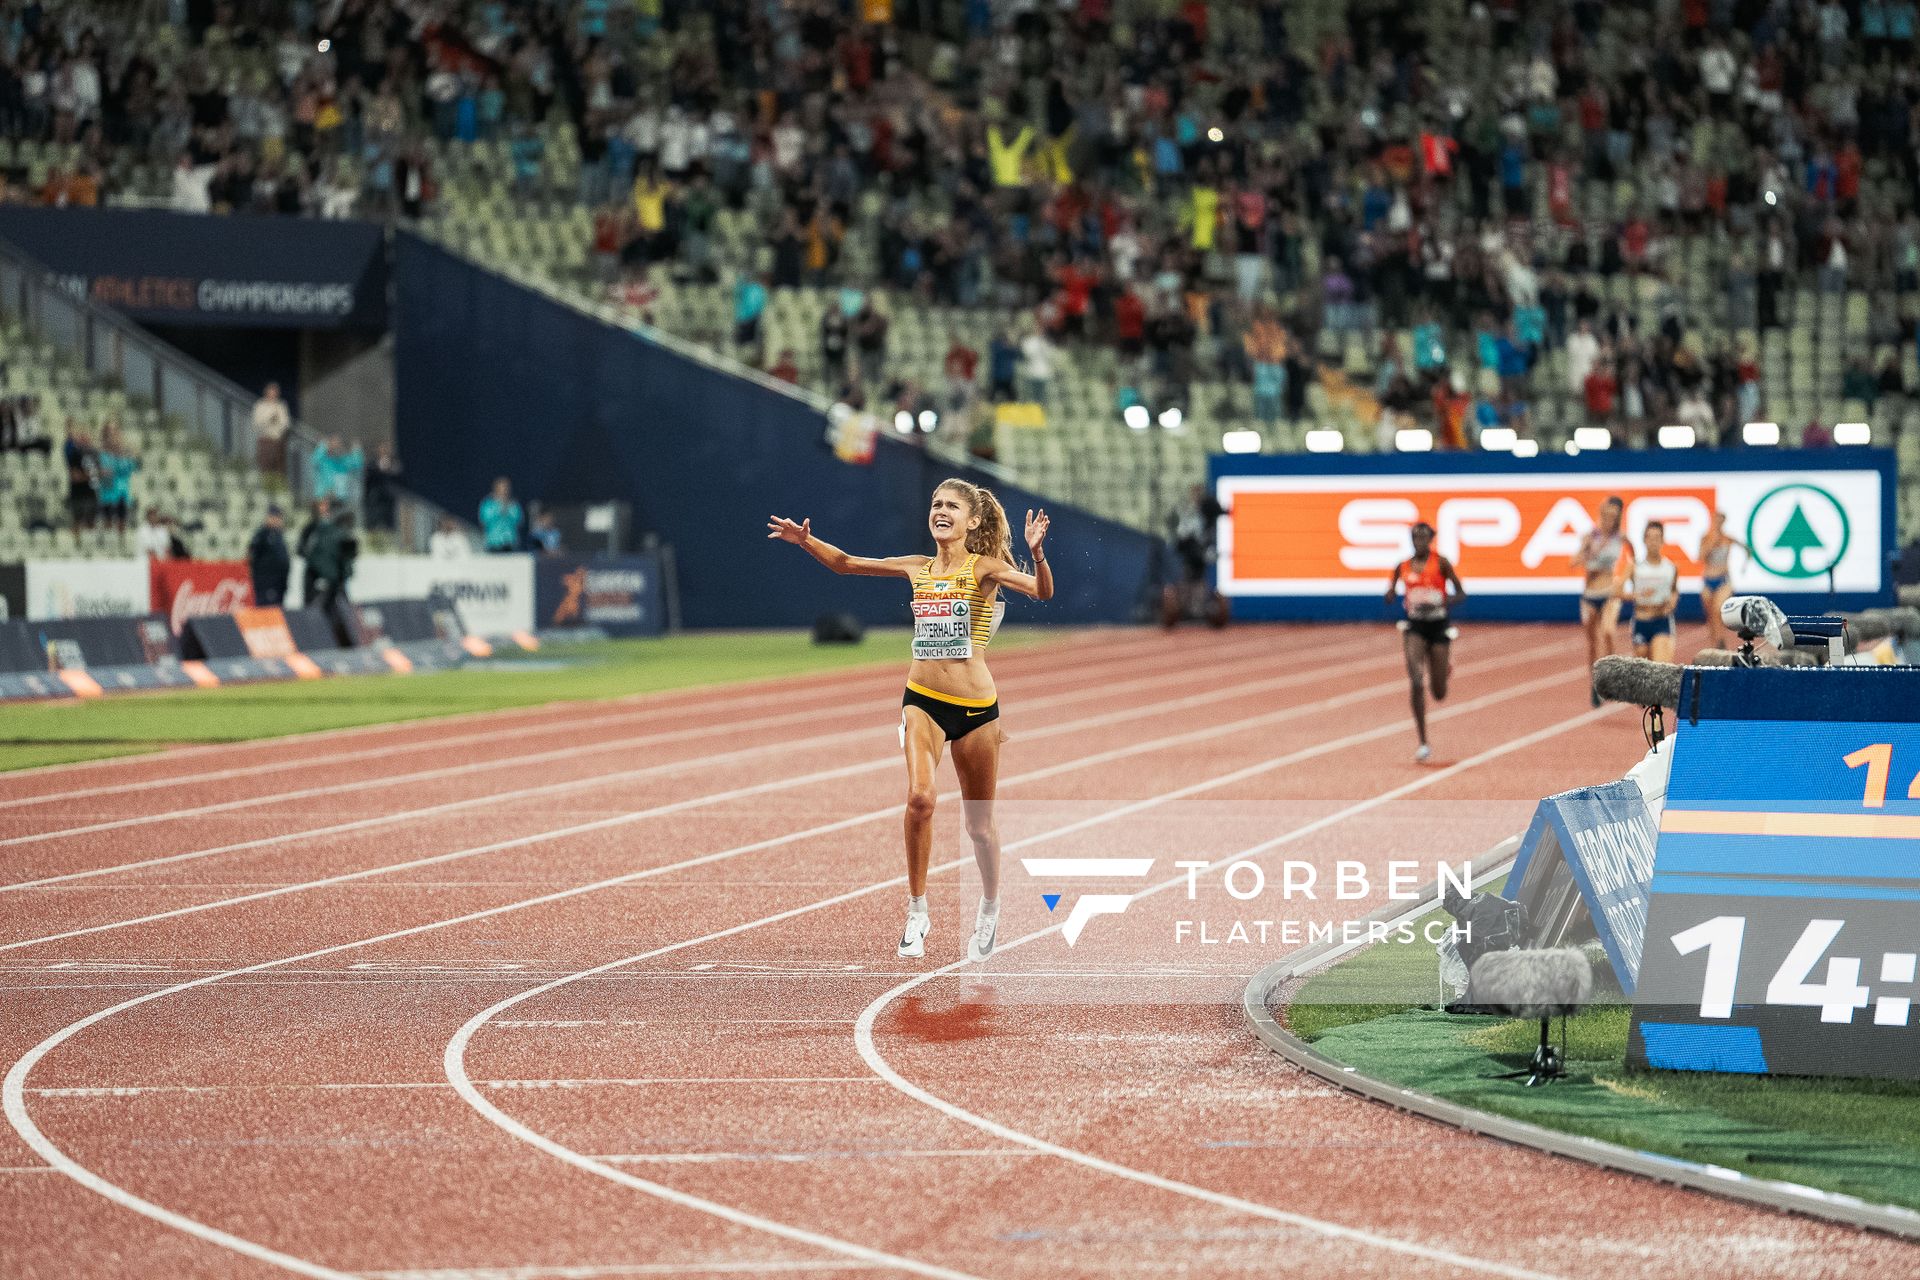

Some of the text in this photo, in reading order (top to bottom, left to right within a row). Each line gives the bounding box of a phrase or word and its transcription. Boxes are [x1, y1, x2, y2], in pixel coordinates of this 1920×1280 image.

[1339, 499, 1714, 569] SPAR
[913, 604, 950, 615] SPAR
[914, 647, 968, 657] MUNICH 2022
